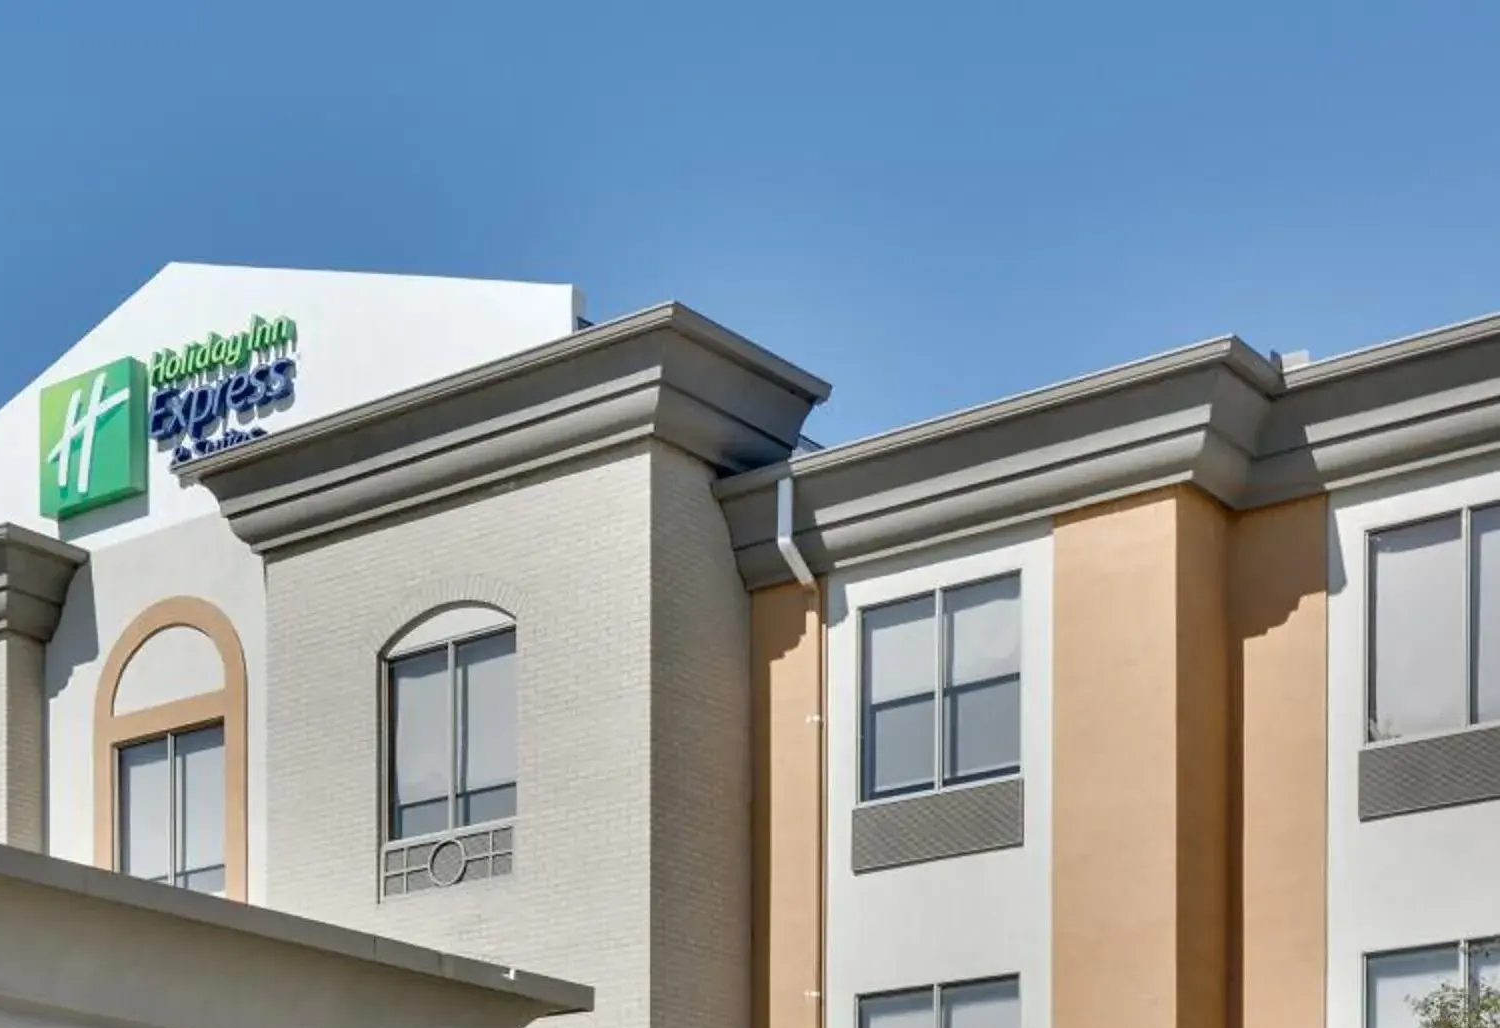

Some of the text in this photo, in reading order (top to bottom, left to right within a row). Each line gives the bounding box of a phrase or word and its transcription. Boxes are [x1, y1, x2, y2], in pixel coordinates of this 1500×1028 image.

[150, 314, 296, 386] Holiday Inn
[149, 357, 294, 441] Express
